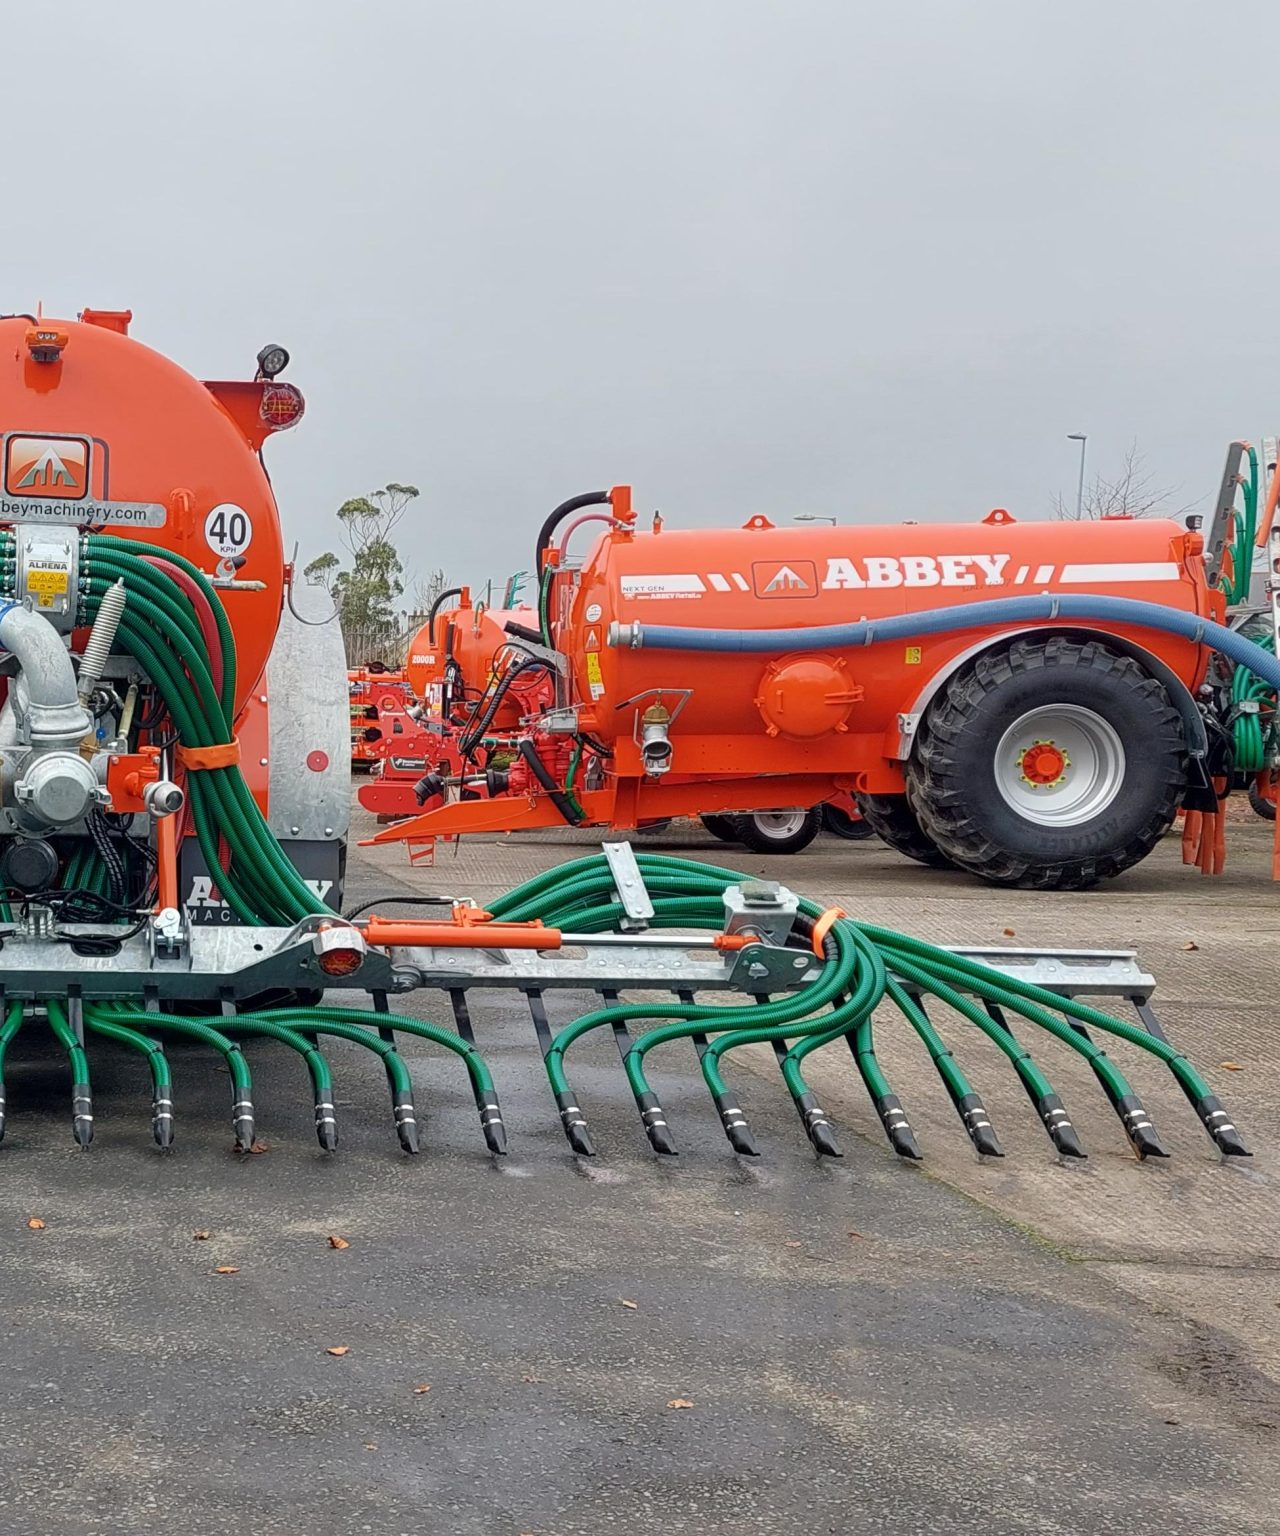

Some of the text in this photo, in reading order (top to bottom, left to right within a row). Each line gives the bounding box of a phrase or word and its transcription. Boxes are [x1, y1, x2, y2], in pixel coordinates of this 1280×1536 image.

[209, 511, 247, 546] 40
[28, 561, 68, 570] ALRENA
[821, 554, 1011, 590] ABBEY
